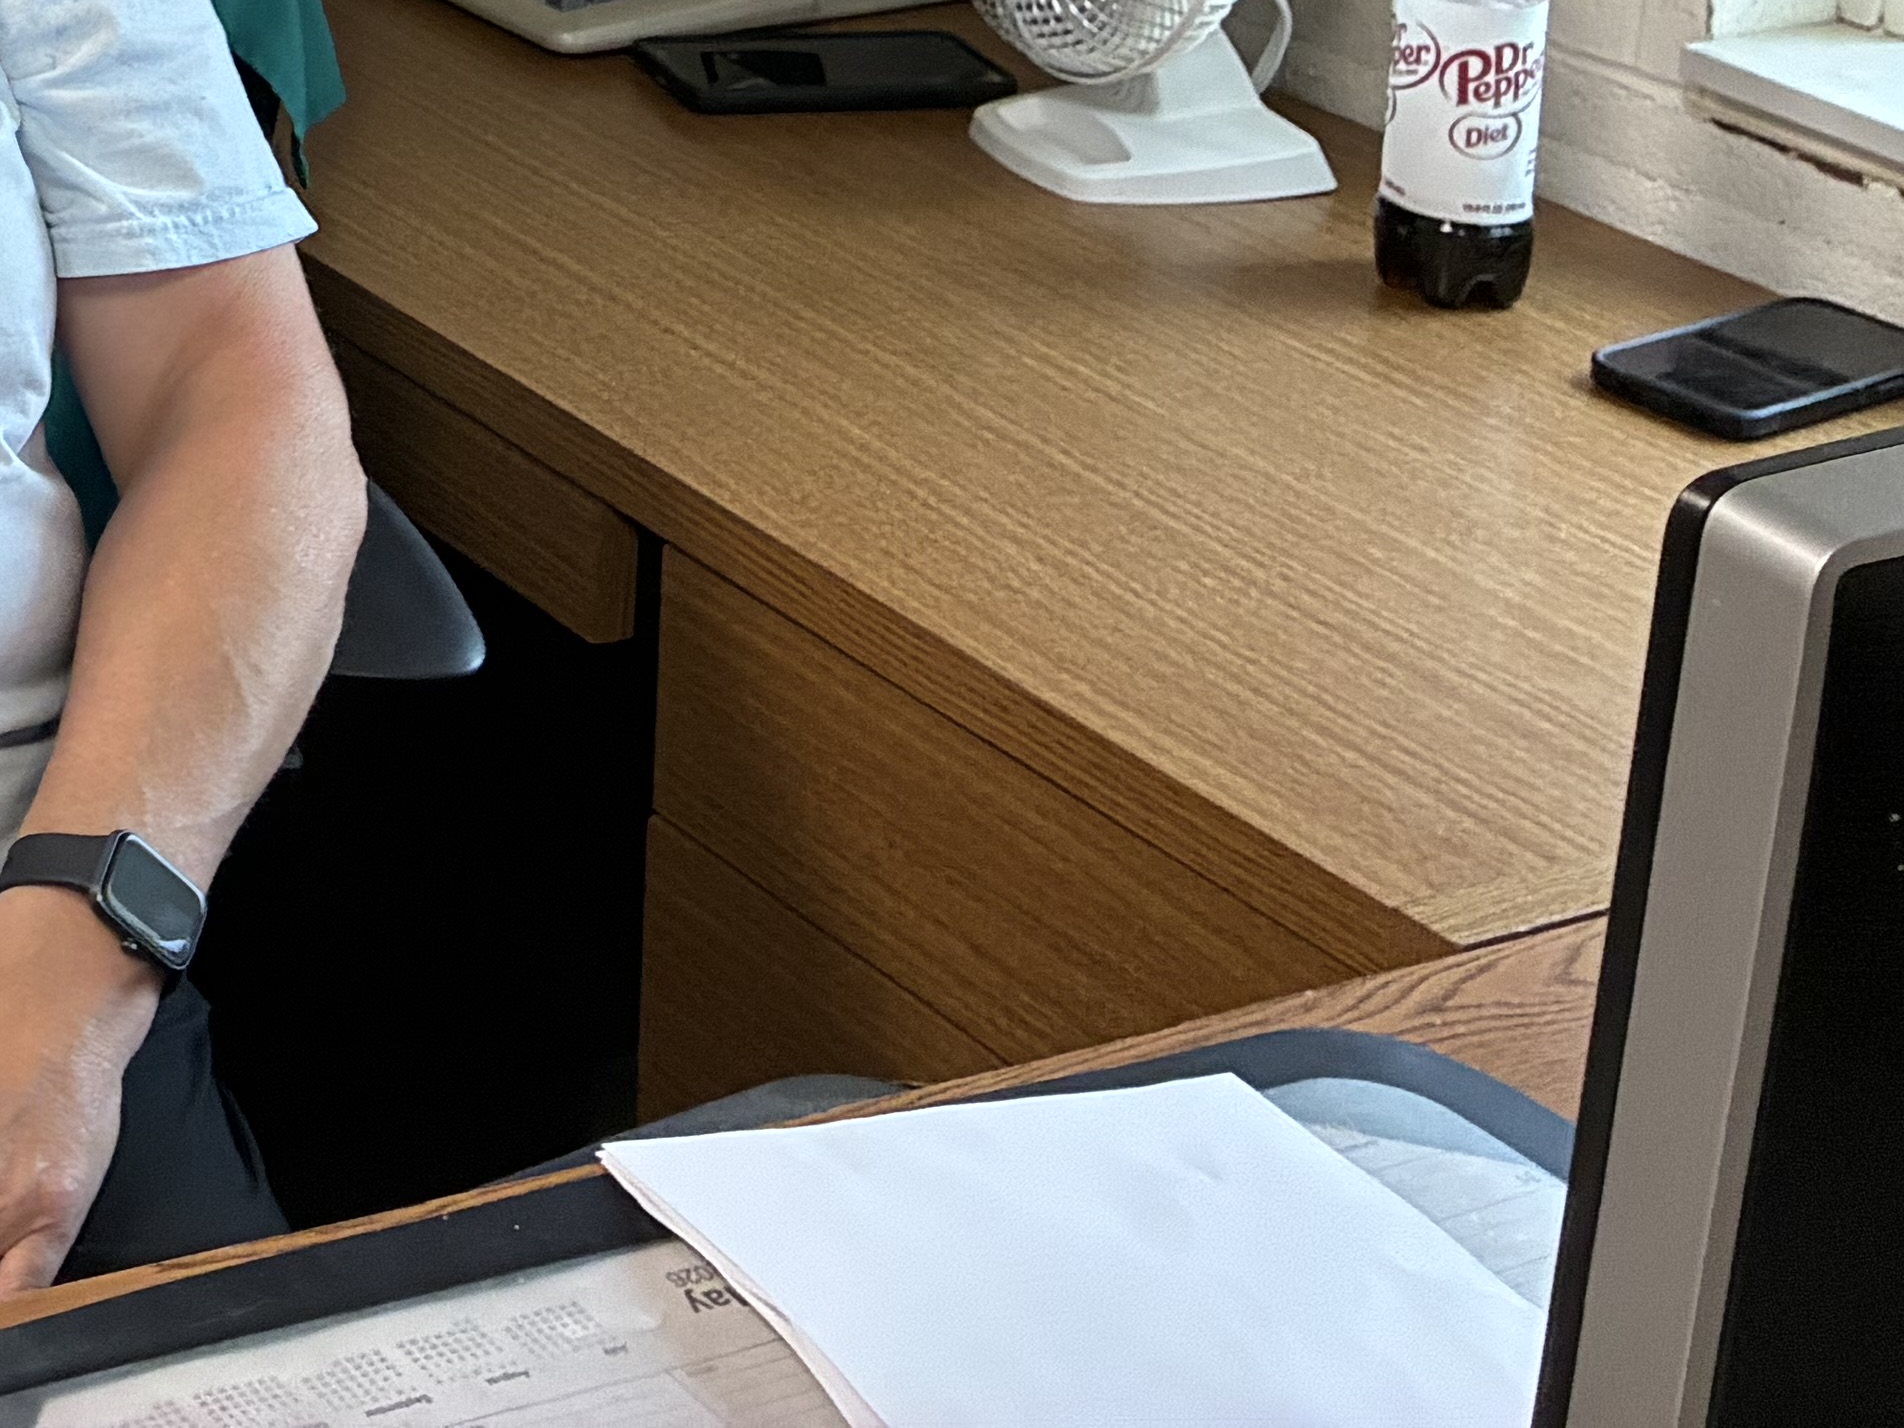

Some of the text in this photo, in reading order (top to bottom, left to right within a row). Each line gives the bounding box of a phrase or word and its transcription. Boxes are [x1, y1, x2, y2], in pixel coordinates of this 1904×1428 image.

[1494, 41, 1534, 77] Dr
[1439, 49, 1542, 109] Pepp
[1465, 122, 1509, 148] Diet
